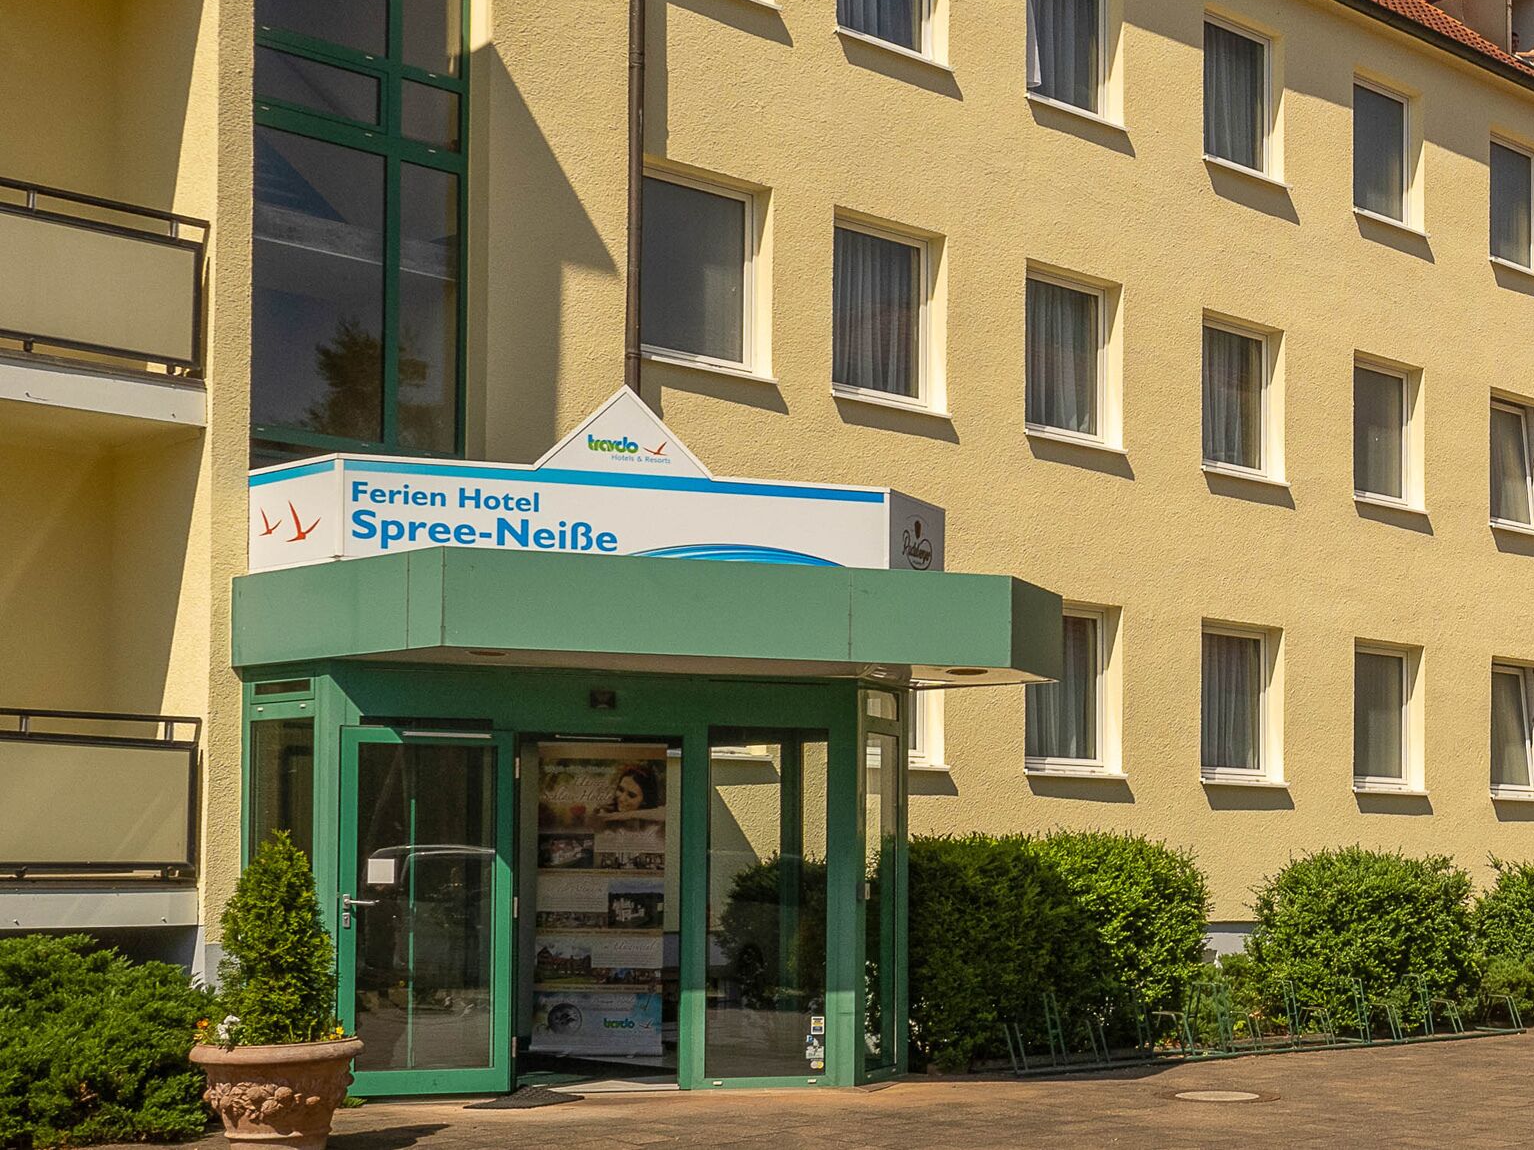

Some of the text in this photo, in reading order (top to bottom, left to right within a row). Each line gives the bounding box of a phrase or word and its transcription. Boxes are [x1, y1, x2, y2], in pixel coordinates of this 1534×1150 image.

[588, 434, 639, 453] travdo
[644, 456, 671, 464] Resorts
[351, 480, 540, 513] Ferien Hotel
[351, 508, 619, 552] Spree-Neiße
